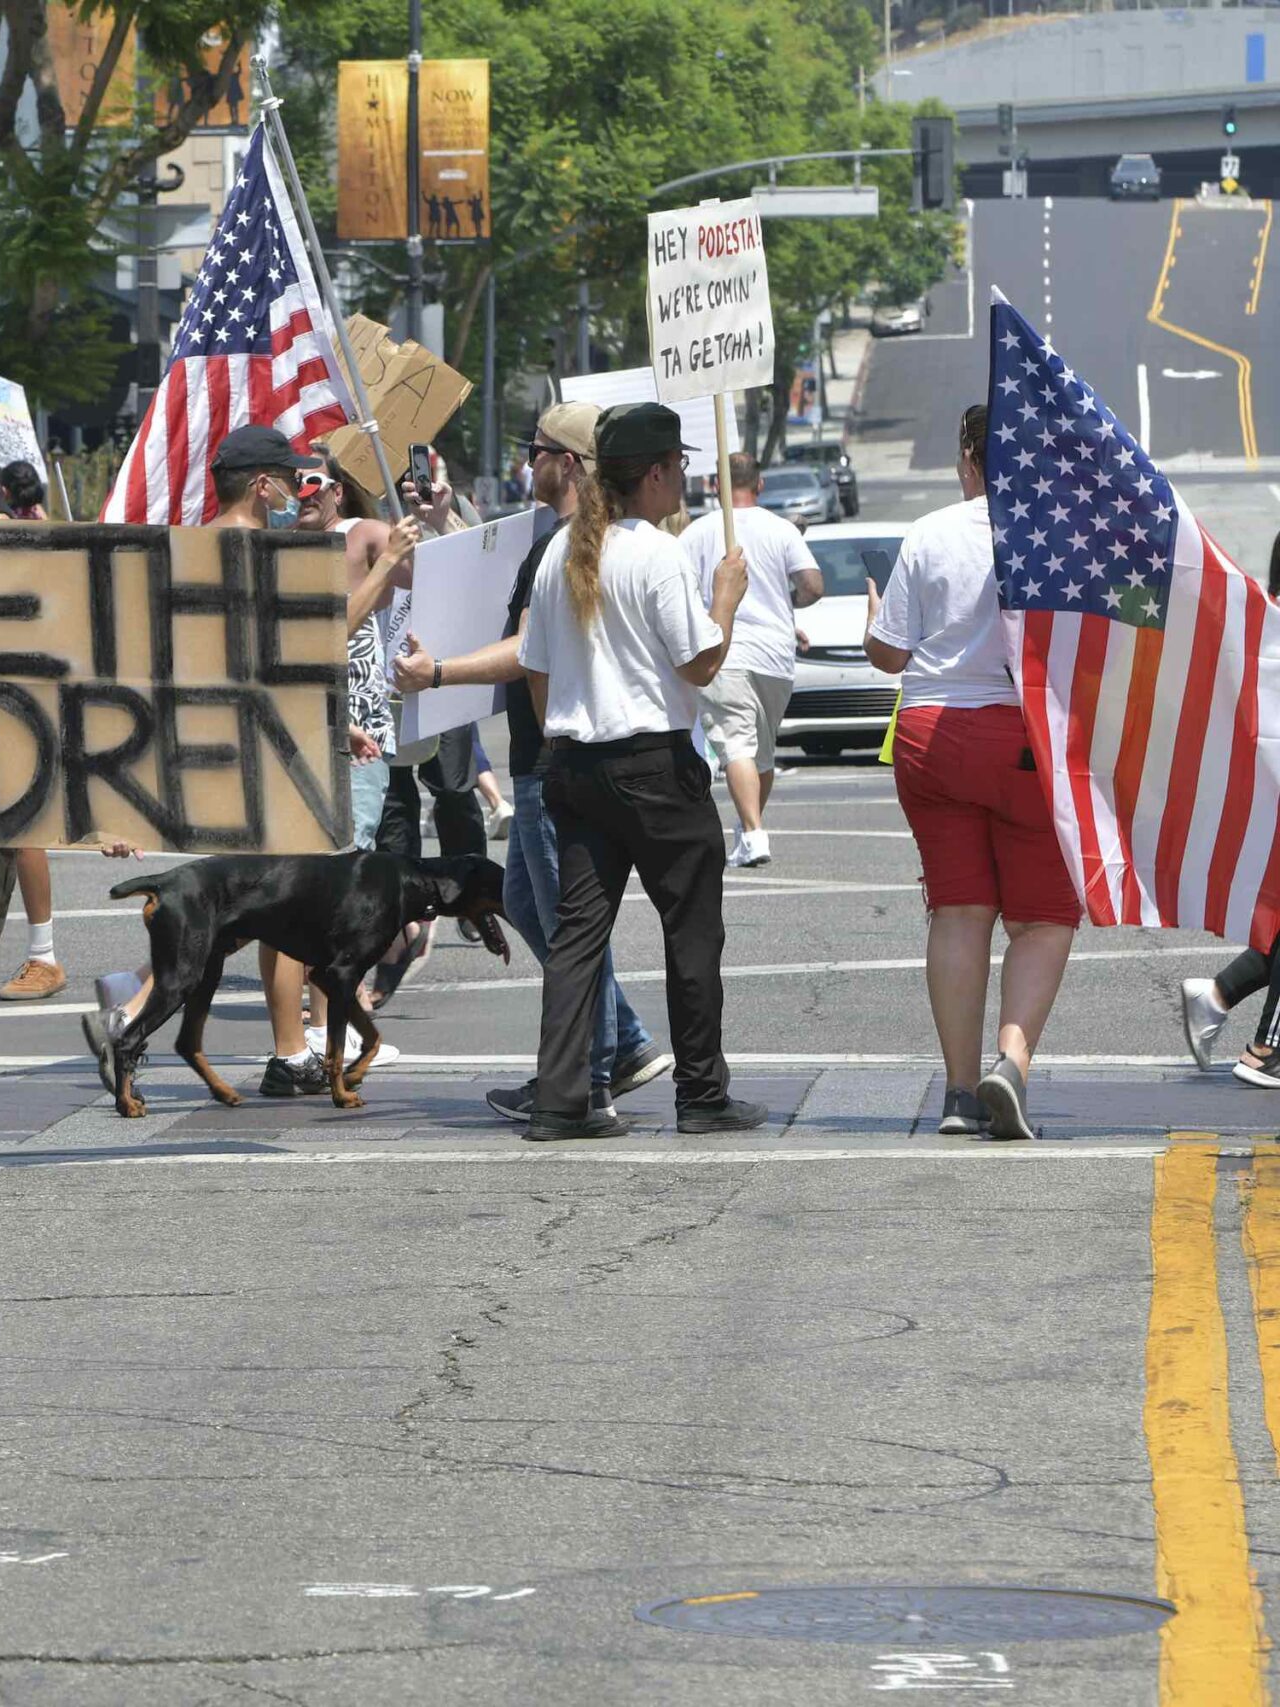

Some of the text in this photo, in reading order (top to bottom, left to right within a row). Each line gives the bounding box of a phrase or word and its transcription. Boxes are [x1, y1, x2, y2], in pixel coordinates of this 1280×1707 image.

[431, 88, 477, 103] NOW
[654, 213, 761, 266] HEY PODESTA!
[658, 269, 757, 323] WE'RE COMIN'
[660, 345, 682, 379] TA
